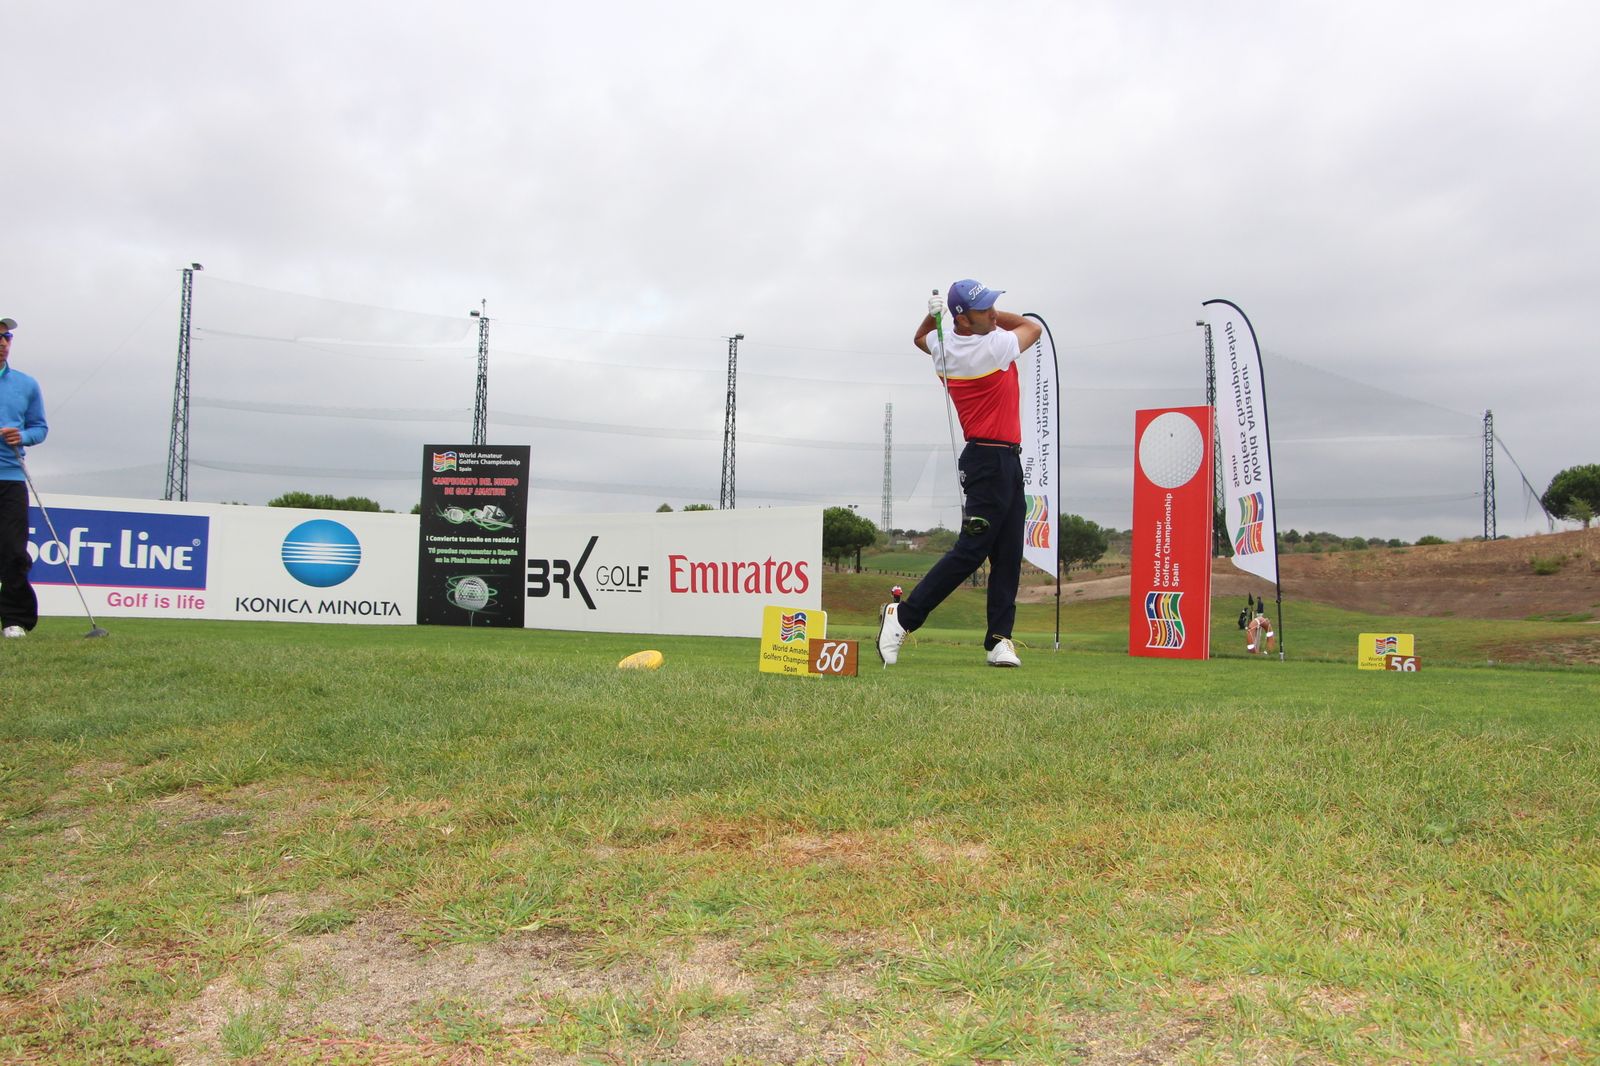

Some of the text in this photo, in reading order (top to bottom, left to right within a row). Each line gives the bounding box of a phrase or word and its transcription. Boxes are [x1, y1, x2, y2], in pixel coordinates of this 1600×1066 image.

[1163, 493, 1173, 554] Championship
[596, 566, 649, 587] GOLF
[668, 555, 809, 594] Emirates
[107, 592, 206, 610] Golf is life
[235, 597, 402, 616] KONICA MINOLTA
[763, 653, 782, 661] Golfers
[772, 644, 788, 652] World
[816, 642, 848, 672] 56
[784, 665, 797, 673] Spain
[1391, 657, 1416, 672] 56
